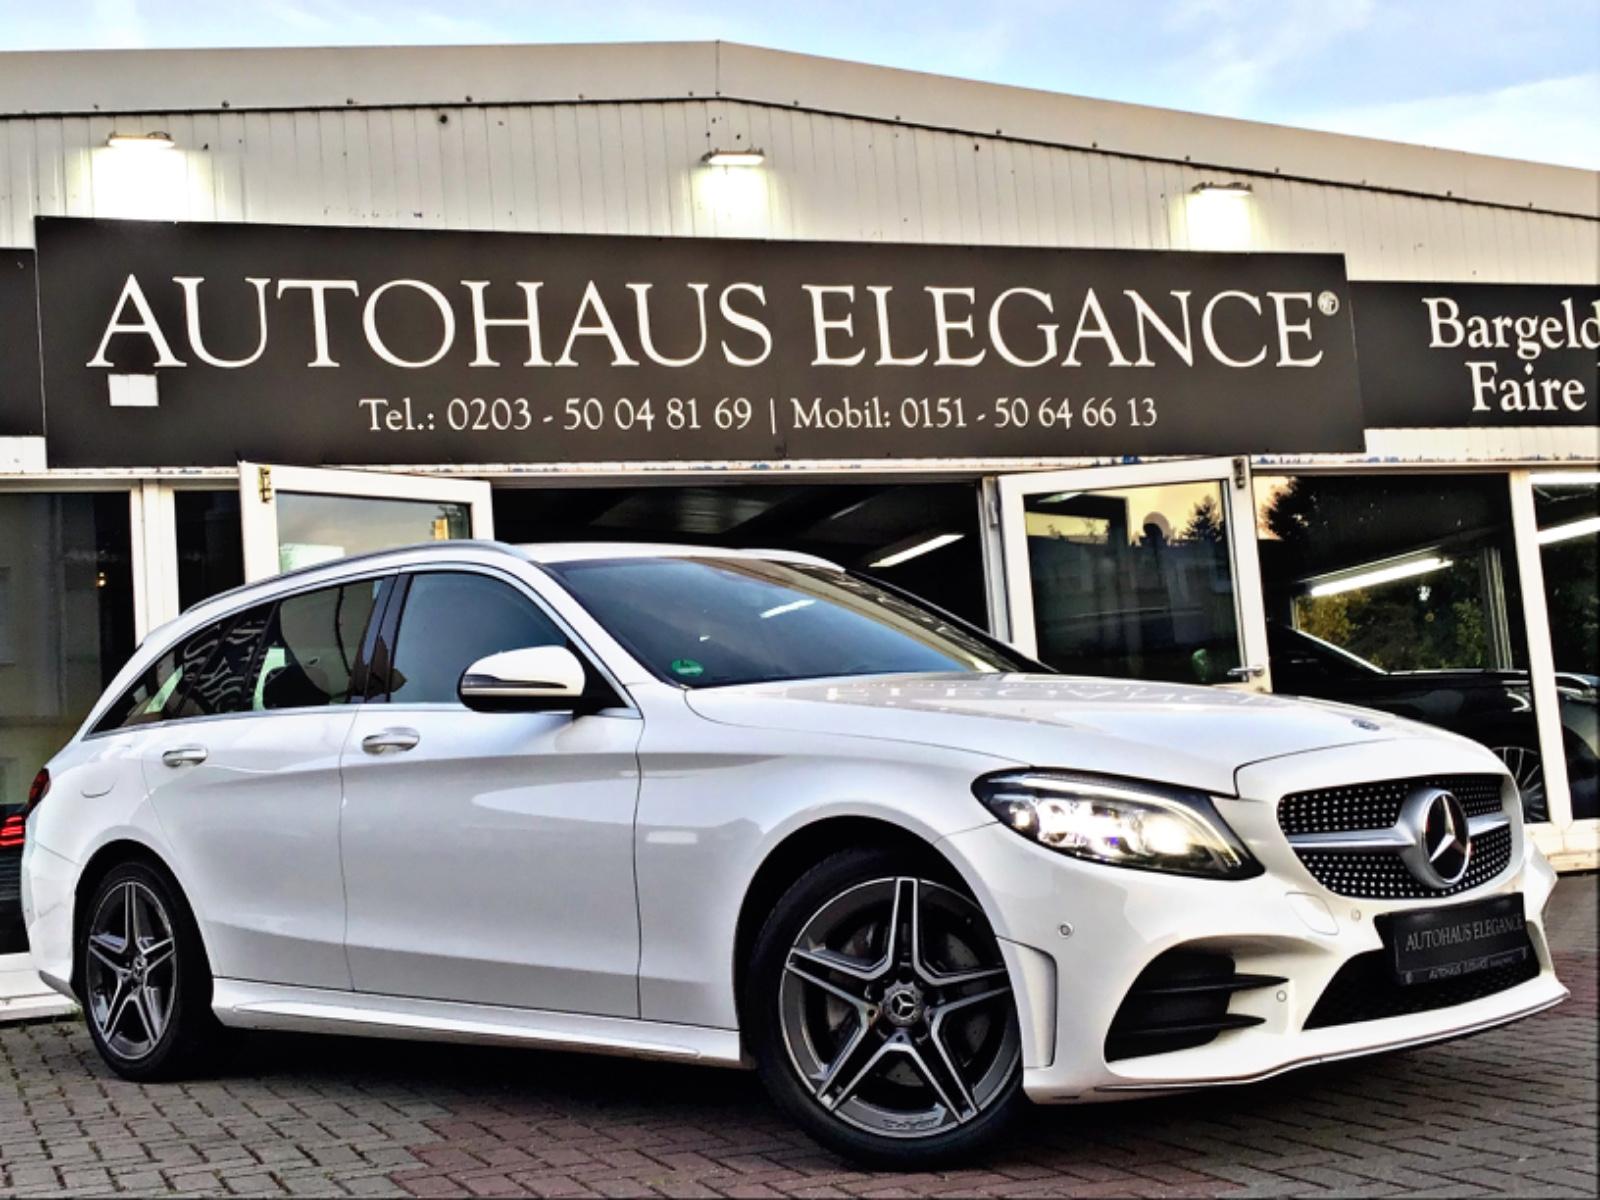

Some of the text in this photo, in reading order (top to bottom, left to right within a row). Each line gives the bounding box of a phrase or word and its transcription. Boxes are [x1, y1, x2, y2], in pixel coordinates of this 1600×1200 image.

[86, 273, 1324, 369] AUTOHAUS ELEGANCE
[1421, 297, 1600, 360] Bargeld
[1464, 361, 1588, 413] Faire
[358, 397, 435, 431] Tel.:
[447, 397, 532, 431] 0203
[563, 397, 604, 431] 50
[614, 397, 656, 432] 04
[666, 397, 702, 430] 81
[714, 397, 753, 430] 69
[789, 397, 891, 429] Mobil:
[900, 397, 968, 429] 0151
[994, 397, 1029, 428] 50
[1038, 397, 1074, 430] 64
[1081, 397, 1117, 427] 66
[1127, 397, 1158, 427] 13
[1405, 912, 1524, 951] AUTOHAUS ELEGANCE
